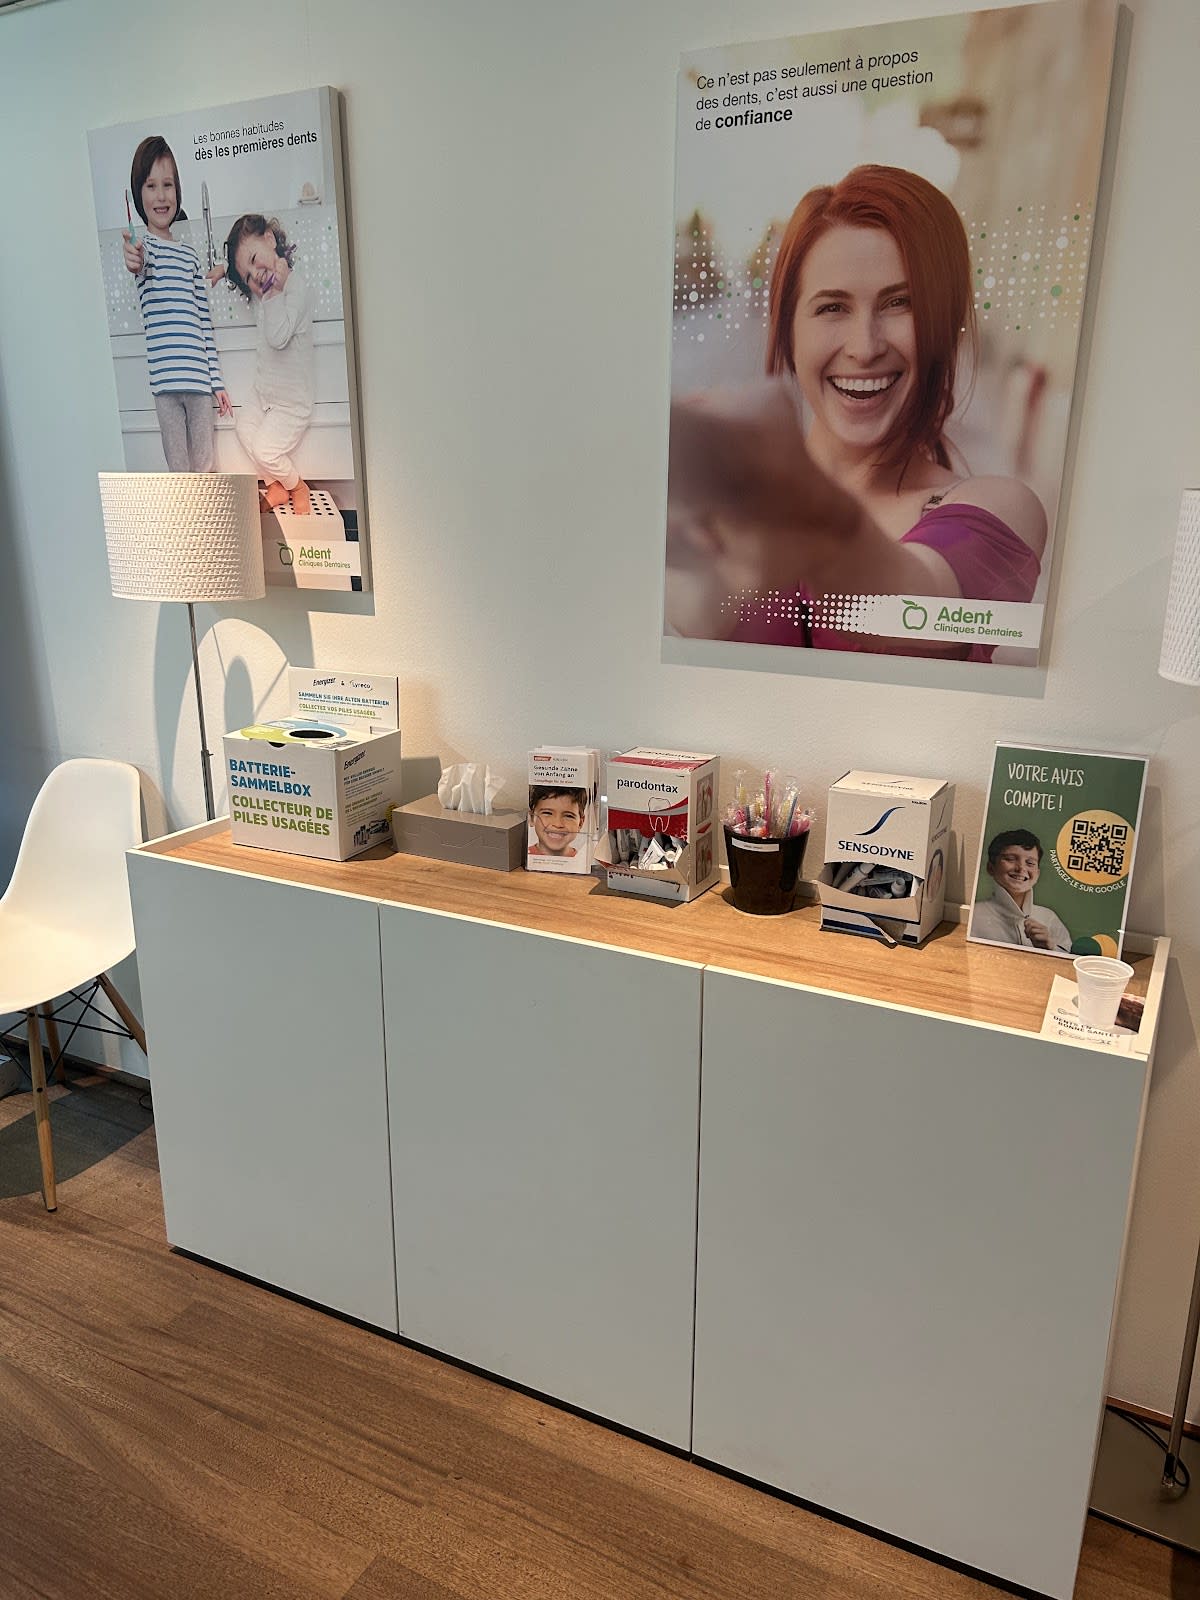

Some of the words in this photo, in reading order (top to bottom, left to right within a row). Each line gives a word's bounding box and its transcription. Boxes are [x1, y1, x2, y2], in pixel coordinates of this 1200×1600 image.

[696, 75, 714, 90] Ce
[753, 69, 777, 85] pas
[781, 57, 851, 79] seulement
[855, 55, 864, 70] à
[868, 50, 919, 71] propos
[696, 96, 719, 110] des
[722, 90, 762, 107] dents,
[802, 80, 837, 98] aussi
[841, 78, 867, 93] une
[871, 69, 933, 92] question
[695, 117, 711, 131] de
[715, 107, 793, 129] confiance
[193, 134, 208, 145] Les
[210, 129, 240, 142] bonnes
[242, 120, 285, 136] habitudes
[194, 148, 213, 161] dès
[215, 146, 230, 158] les
[232, 137, 284, 157] premières
[287, 130, 318, 146] dents
[299, 546, 331, 560] Adent
[298, 560, 323, 568] Cliniques
[324, 561, 351, 569] Dentaires
[937, 606, 993, 625] Adent
[933, 623, 975, 634] Cliniques
[978, 626, 1023, 638] Dentaires
[298, 691, 323, 699] SAMMELN
[332, 694, 344, 702] IHRE
[345, 696, 361, 704] ALTEN
[362, 697, 390, 706] BATTERIEN
[298, 703, 326, 711] COLLECTEZ
[229, 758, 296, 778] BATTERIE-
[1008, 763, 1049, 783] VOTRE
[1051, 767, 1084, 787] AVIS
[231, 775, 312, 797] SAMMELBOX
[617, 778, 678, 794] parodontax
[232, 794, 312, 818] COLLECTEUR
[316, 806, 333, 820] DE
[1004, 789, 1056, 810] COMPTE
[1059, 795, 1063, 812] !
[233, 810, 268, 826] PILES
[271, 816, 330, 836] USAGÉES
[838, 840, 914, 861] SENSODYNE
[1049, 849, 1079, 888] PARTAGEZ-LE
[1079, 884, 1094, 893] SUR
[1095, 879, 1126, 894] GOOGLE
